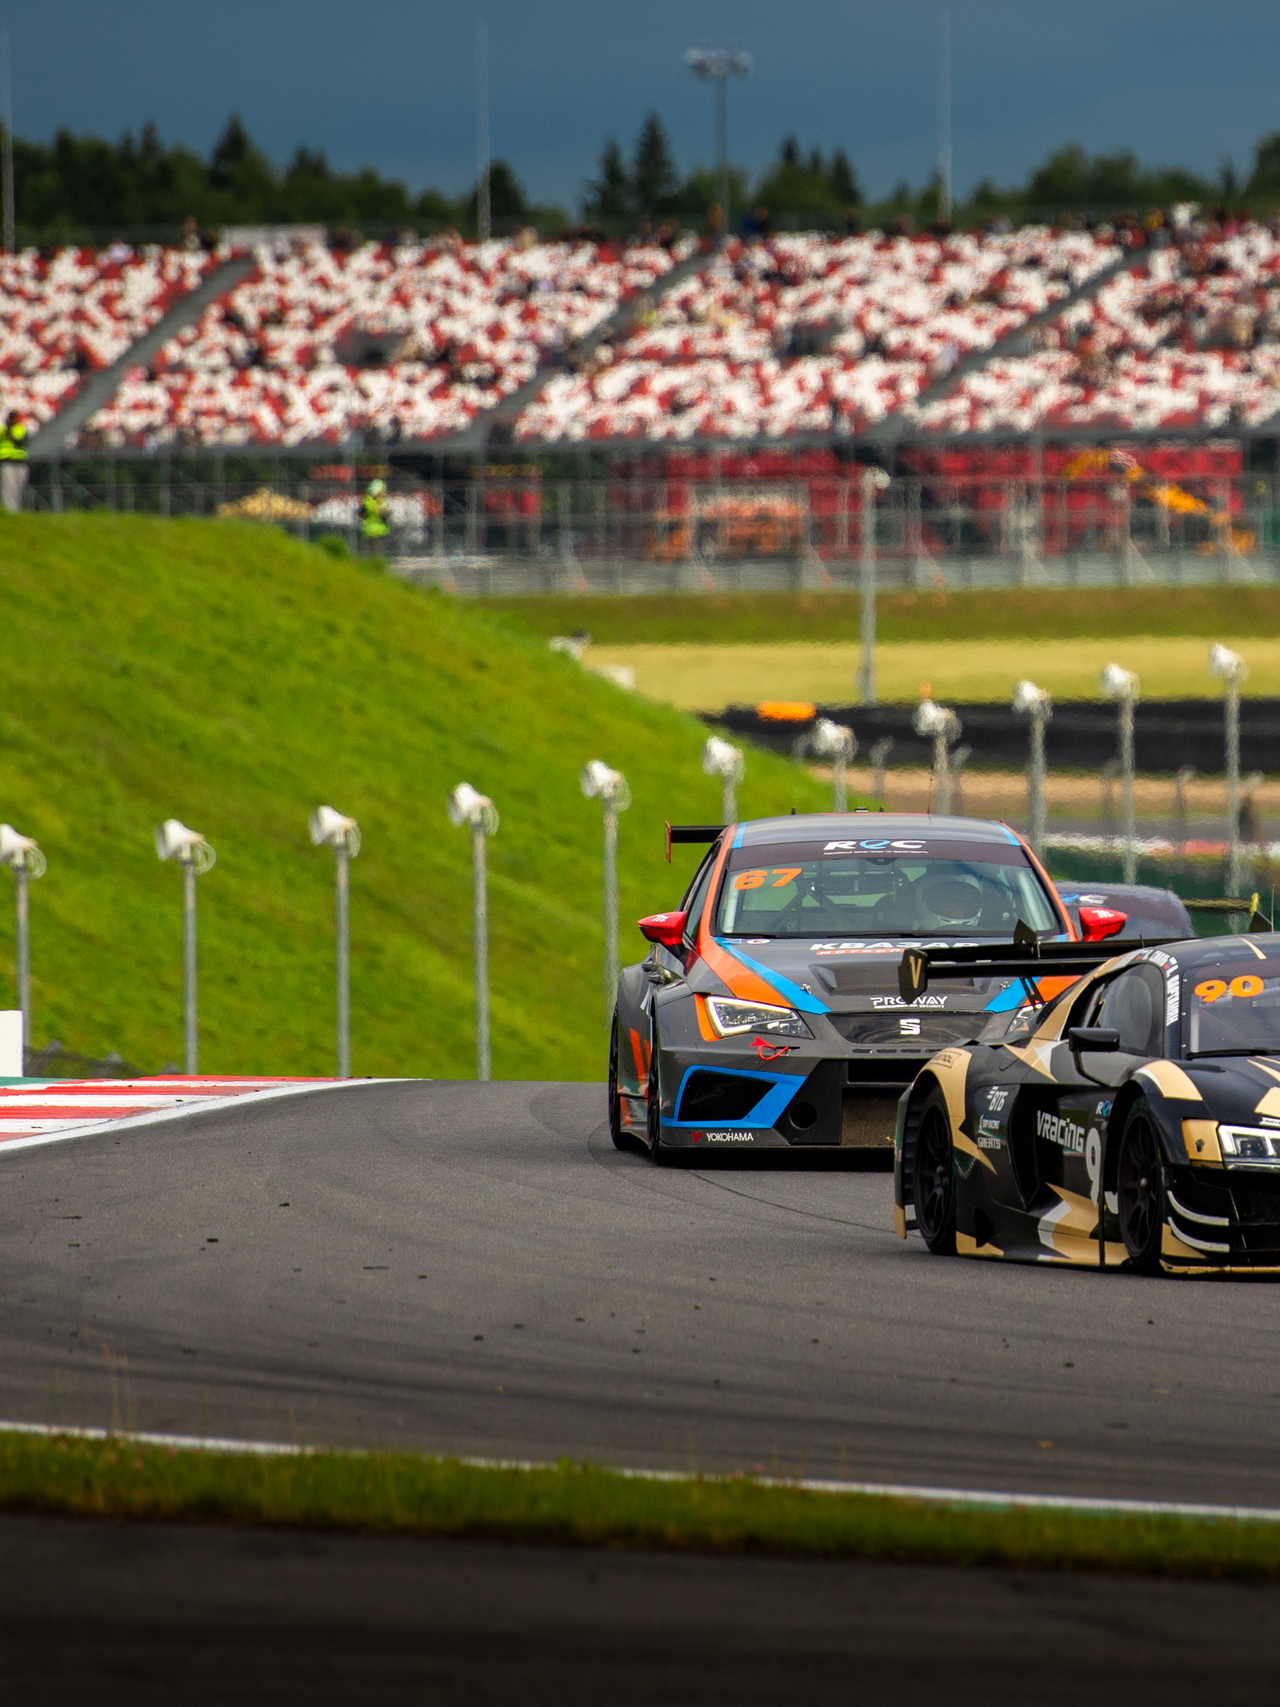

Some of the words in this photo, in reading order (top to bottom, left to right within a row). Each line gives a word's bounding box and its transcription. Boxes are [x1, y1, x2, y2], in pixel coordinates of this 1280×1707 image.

[734, 868, 802, 890] 67
[810, 942, 979, 950] КВАЗАР
[909, 955, 922, 989] V
[1194, 975, 1264, 1003] 90
[706, 1132, 754, 1142] YOKOHAMA
